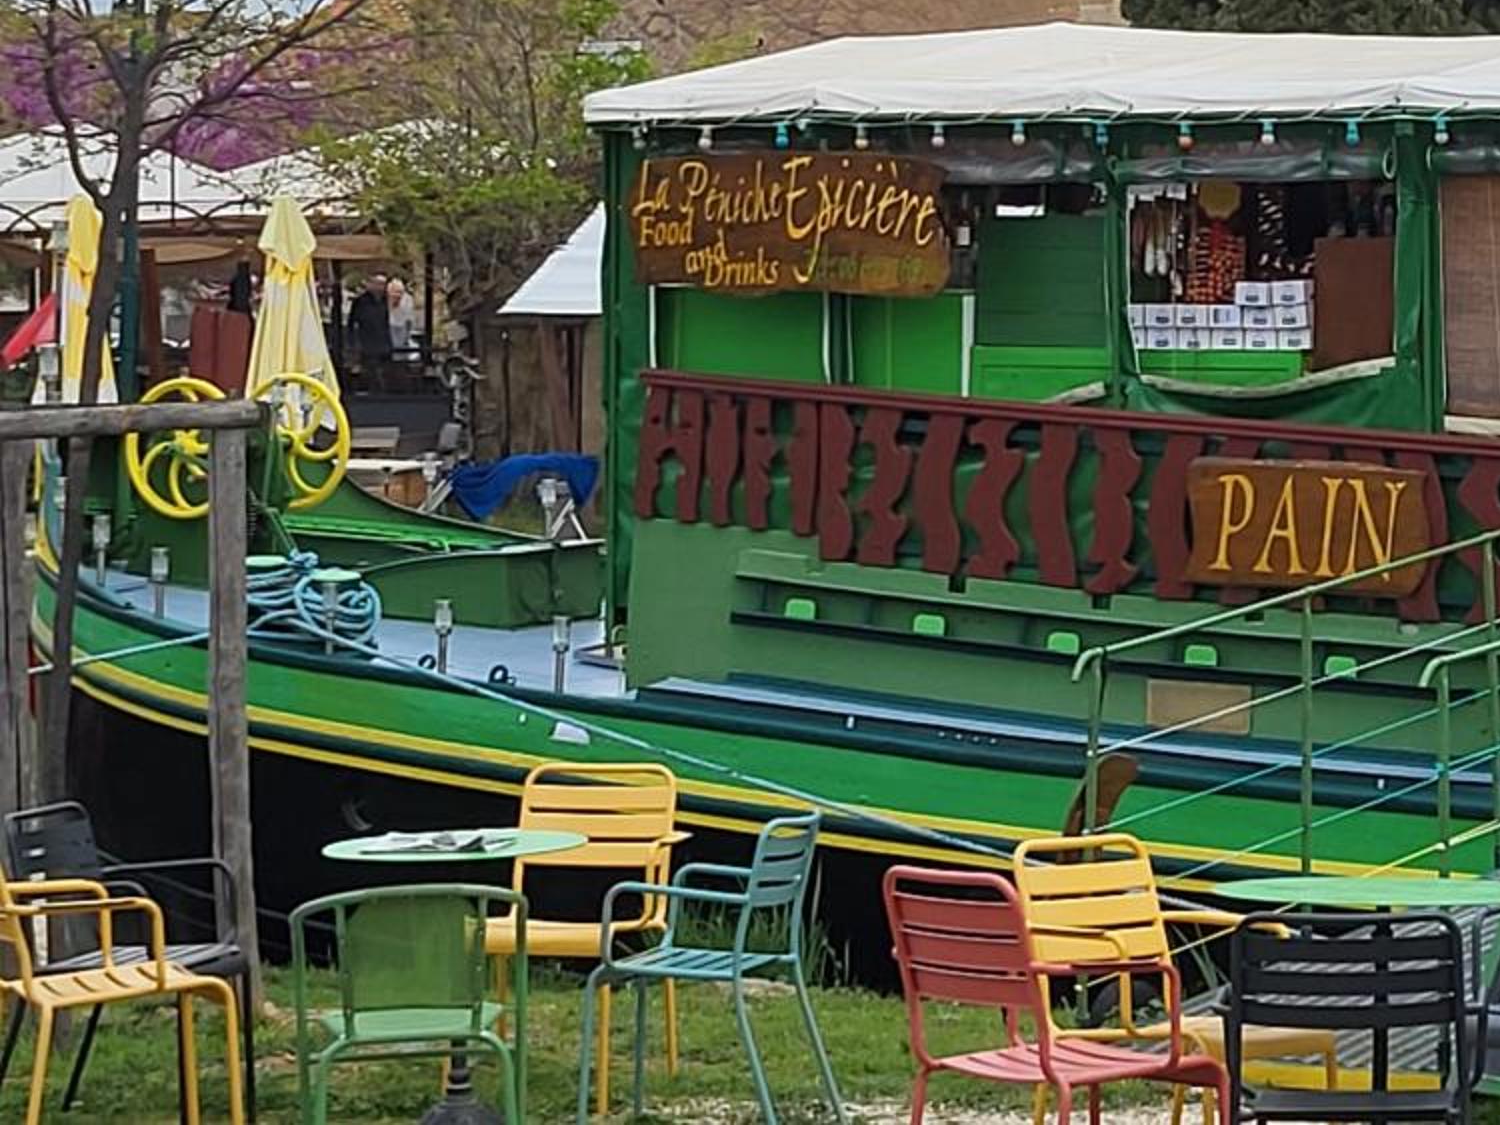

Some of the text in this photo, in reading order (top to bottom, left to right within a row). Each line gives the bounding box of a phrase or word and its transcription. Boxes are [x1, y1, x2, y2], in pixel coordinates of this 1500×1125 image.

[632, 159, 671, 216] La
[679, 160, 782, 223] Péniche
[639, 206, 694, 247] Food
[685, 227, 728, 274] and
[703, 247, 779, 286] Drinks
[1208, 473, 1407, 581] PAIN
